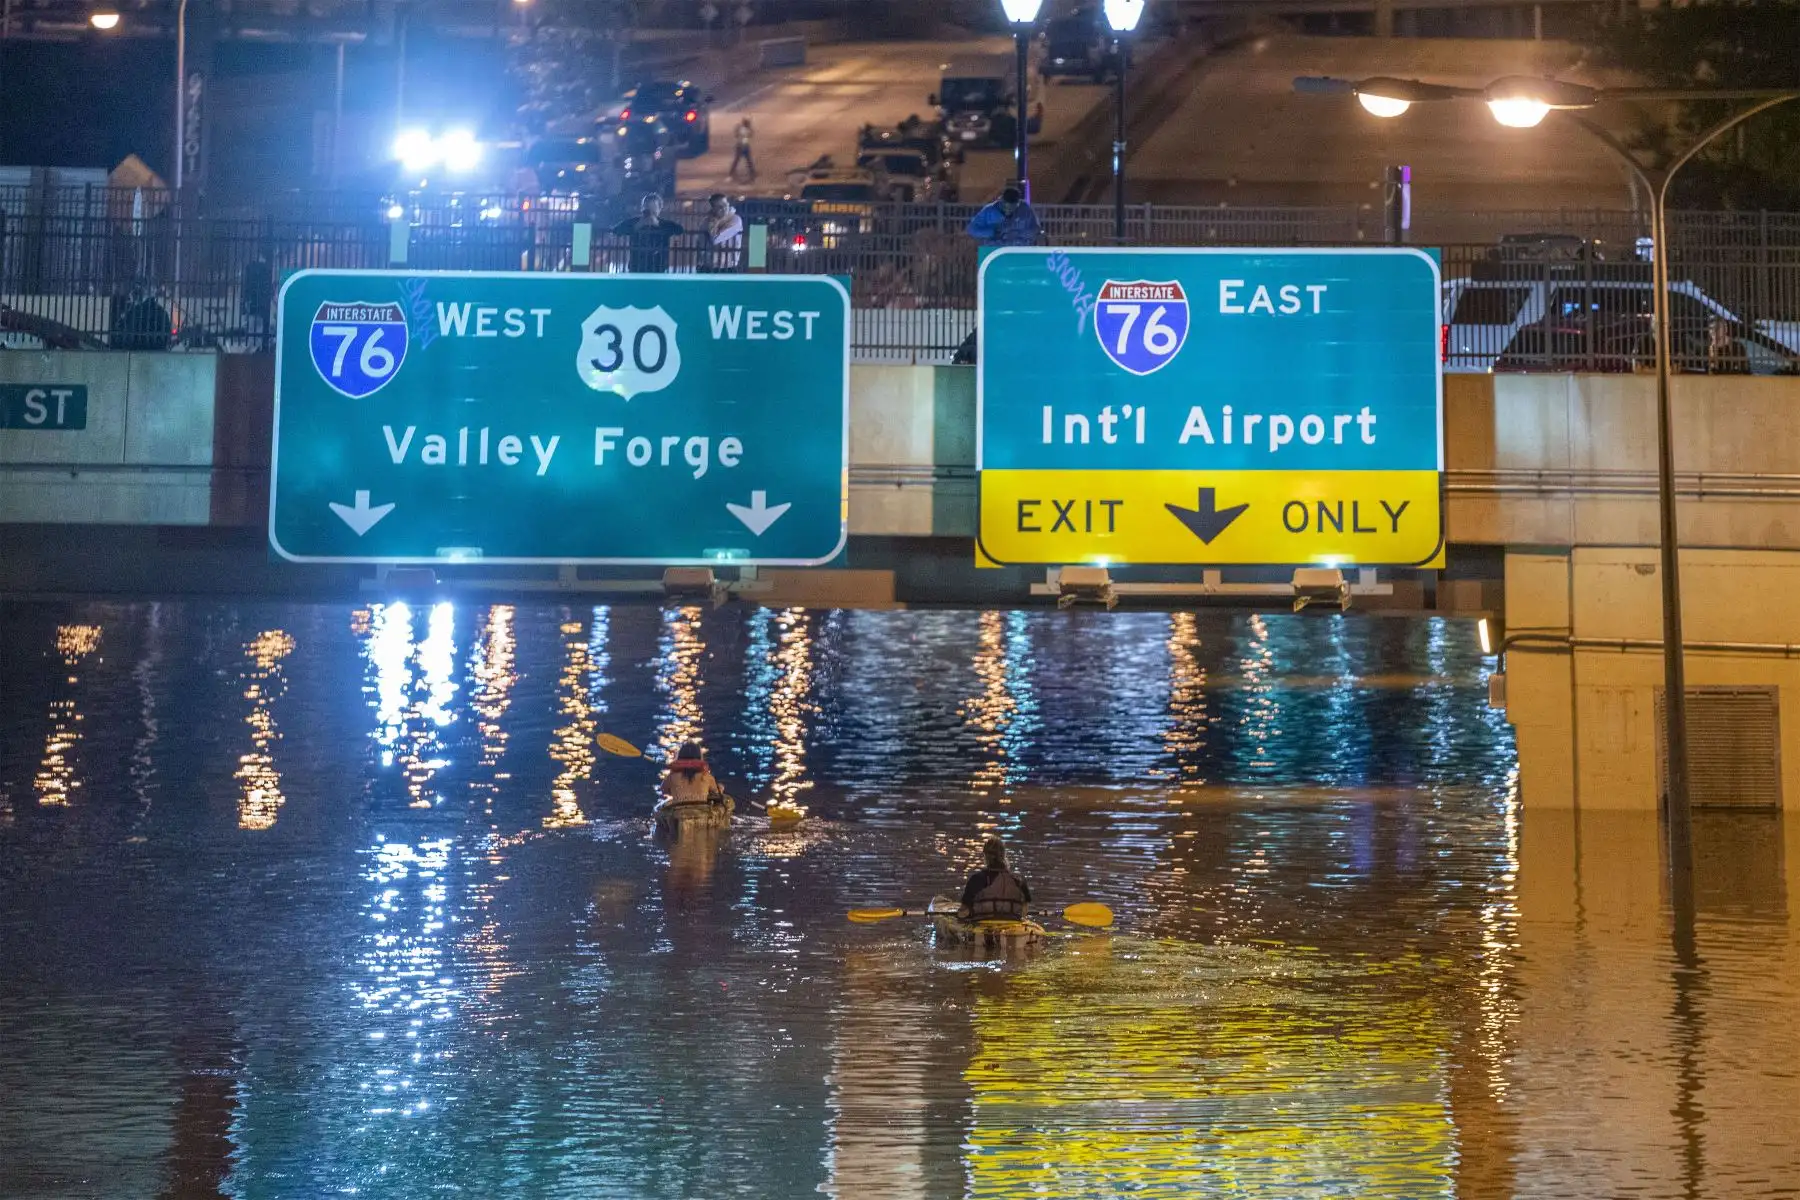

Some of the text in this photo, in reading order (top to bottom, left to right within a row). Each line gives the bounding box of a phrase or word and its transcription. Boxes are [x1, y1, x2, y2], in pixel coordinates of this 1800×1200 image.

[1109, 286, 1174, 299] INTERSTATE
[1220, 279, 1328, 314] EAST
[326, 307, 393, 321] INTERSTATE
[437, 301, 552, 338] WEST
[708, 305, 821, 340] WEST
[1106, 304, 1177, 356] 76
[322, 326, 395, 378] 76
[590, 323, 668, 374] 30
[23, 388, 73, 425] ST
[1042, 404, 1377, 453] Int'l Airport
[382, 425, 744, 480] Valley Forge
[1017, 499, 1411, 534] EXIT ONLY
